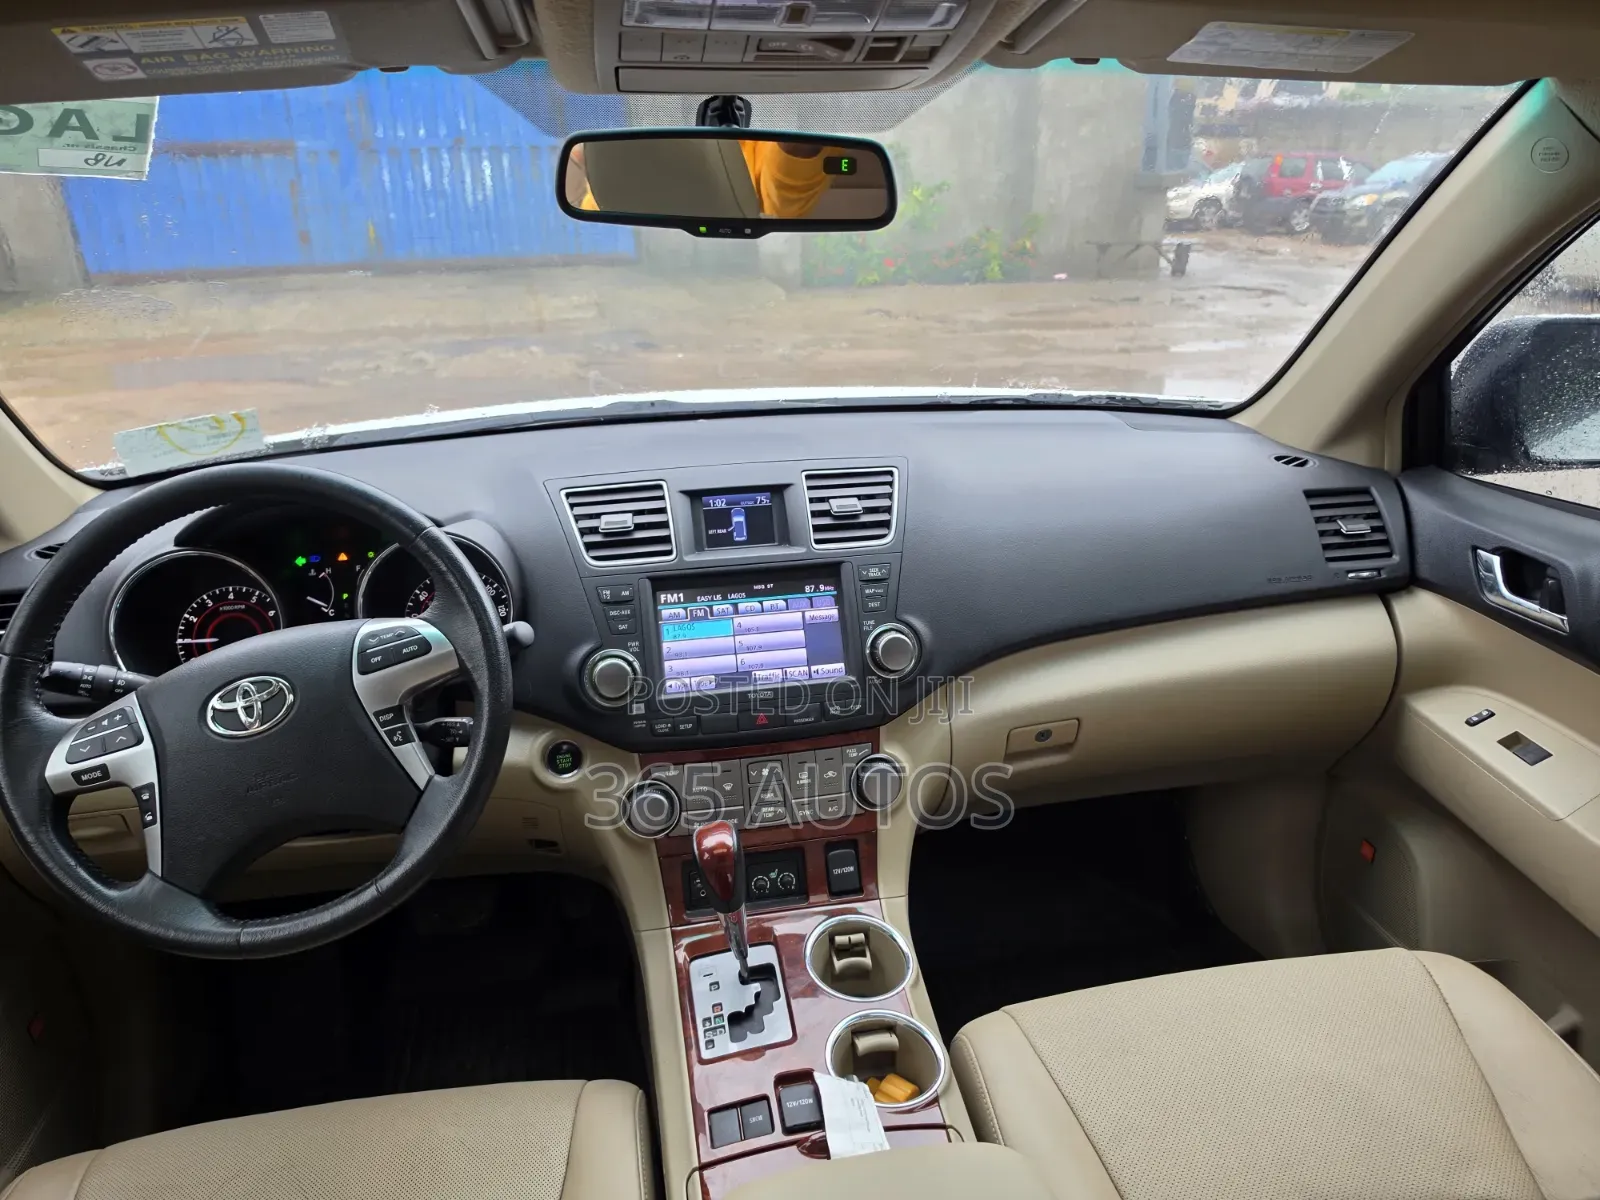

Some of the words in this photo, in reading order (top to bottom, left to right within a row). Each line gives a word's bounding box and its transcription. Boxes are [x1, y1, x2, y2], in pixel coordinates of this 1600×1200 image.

[140, 55, 174, 65] AIR
[182, 51, 230, 62] BAG
[238, 44, 335, 59] WARNING
[842, 160, 848, 171] E
[709, 498, 727, 507] 1:02
[419, 591, 429, 602] 40
[660, 593, 684, 604] FM1
[805, 584, 825, 593] 87.9
[205, 599, 213, 607] 3
[498, 604, 507, 617] 120
[668, 611, 681, 619] AM
[693, 609, 704, 617] FM
[189, 615, 198, 623] 2
[809, 613, 834, 621] Message
[673, 623, 696, 631] LAGOS
[402, 645, 418, 654] AUTO
[666, 646, 672, 654] 2
[371, 655, 382, 663] OFF
[821, 666, 843, 675] Sound
[379, 713, 394, 722] DISP
[81, 770, 103, 782] MODE
[832, 865, 855, 875] 12V/120W
[786, 1098, 813, 1108] 12V/120W
